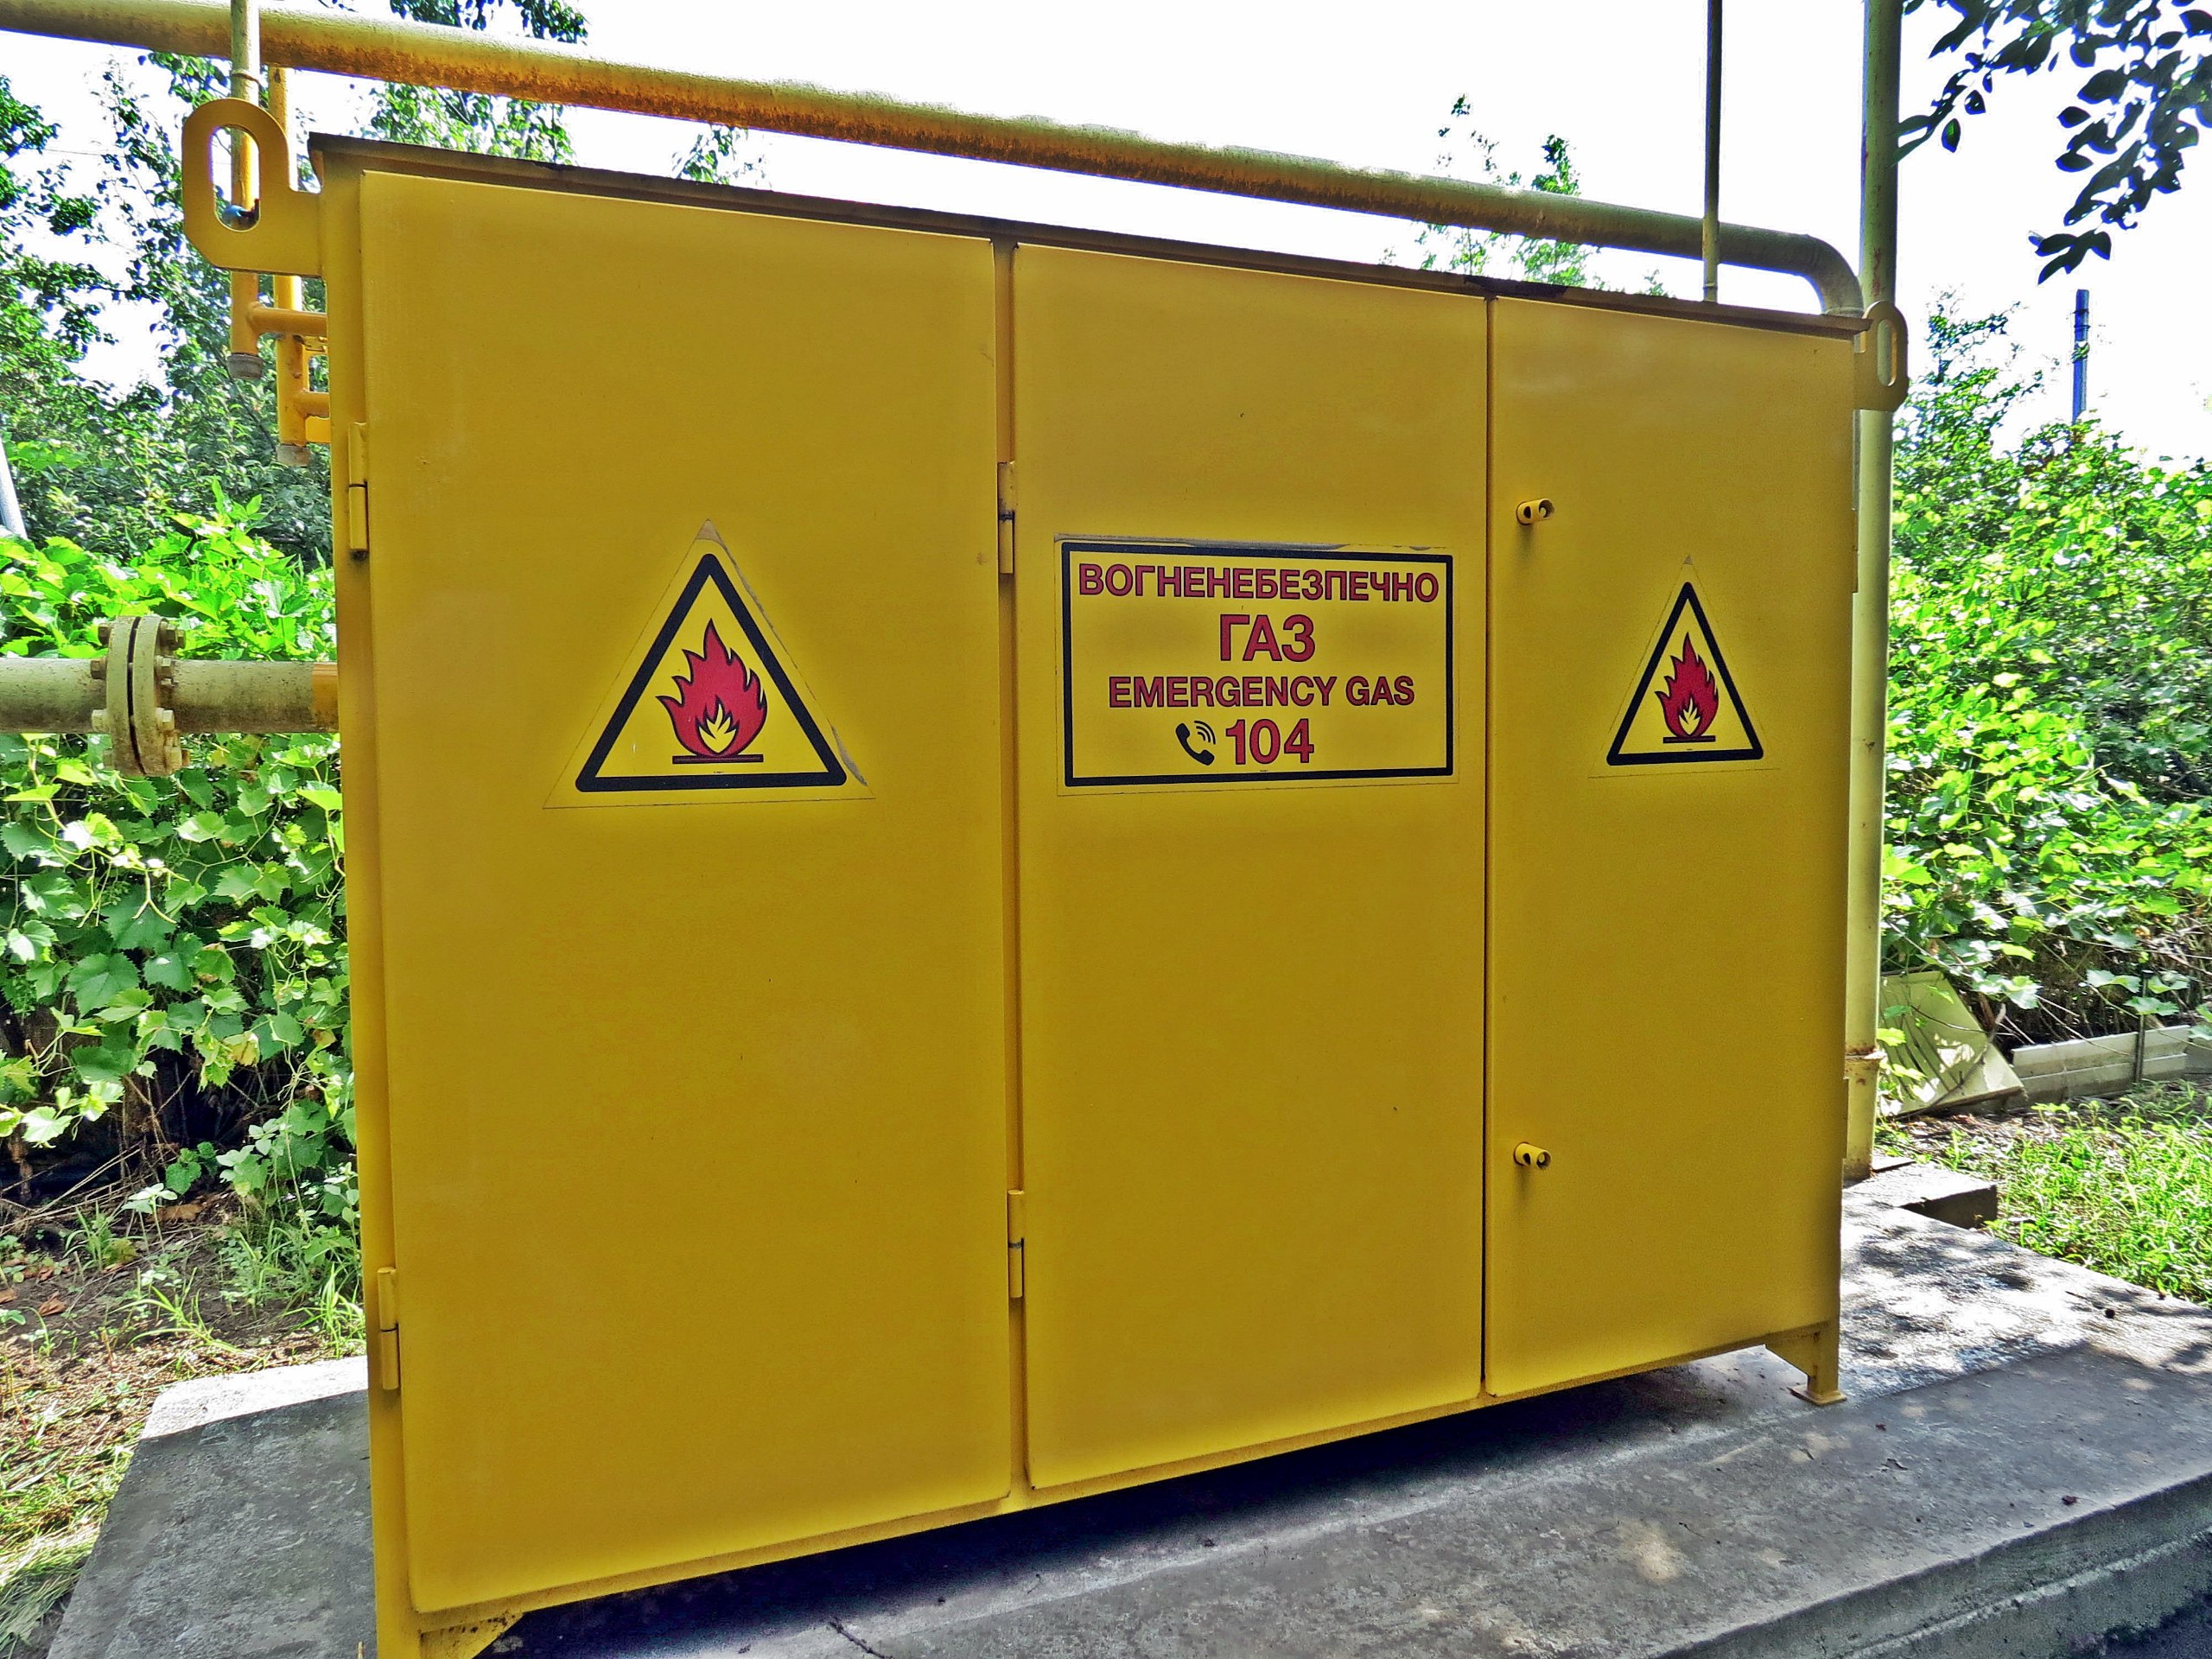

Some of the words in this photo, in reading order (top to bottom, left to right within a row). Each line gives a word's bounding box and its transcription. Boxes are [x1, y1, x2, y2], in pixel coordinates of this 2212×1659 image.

[1078, 563, 1440, 602] ВОГНЕНЕБЕЗПЕЧНО
[1220, 613, 1316, 663] ГАЗ
[1109, 676, 1337, 708] EMERGENCY
[1345, 676, 1415, 706] GAS
[1225, 718, 1315, 766] 104
